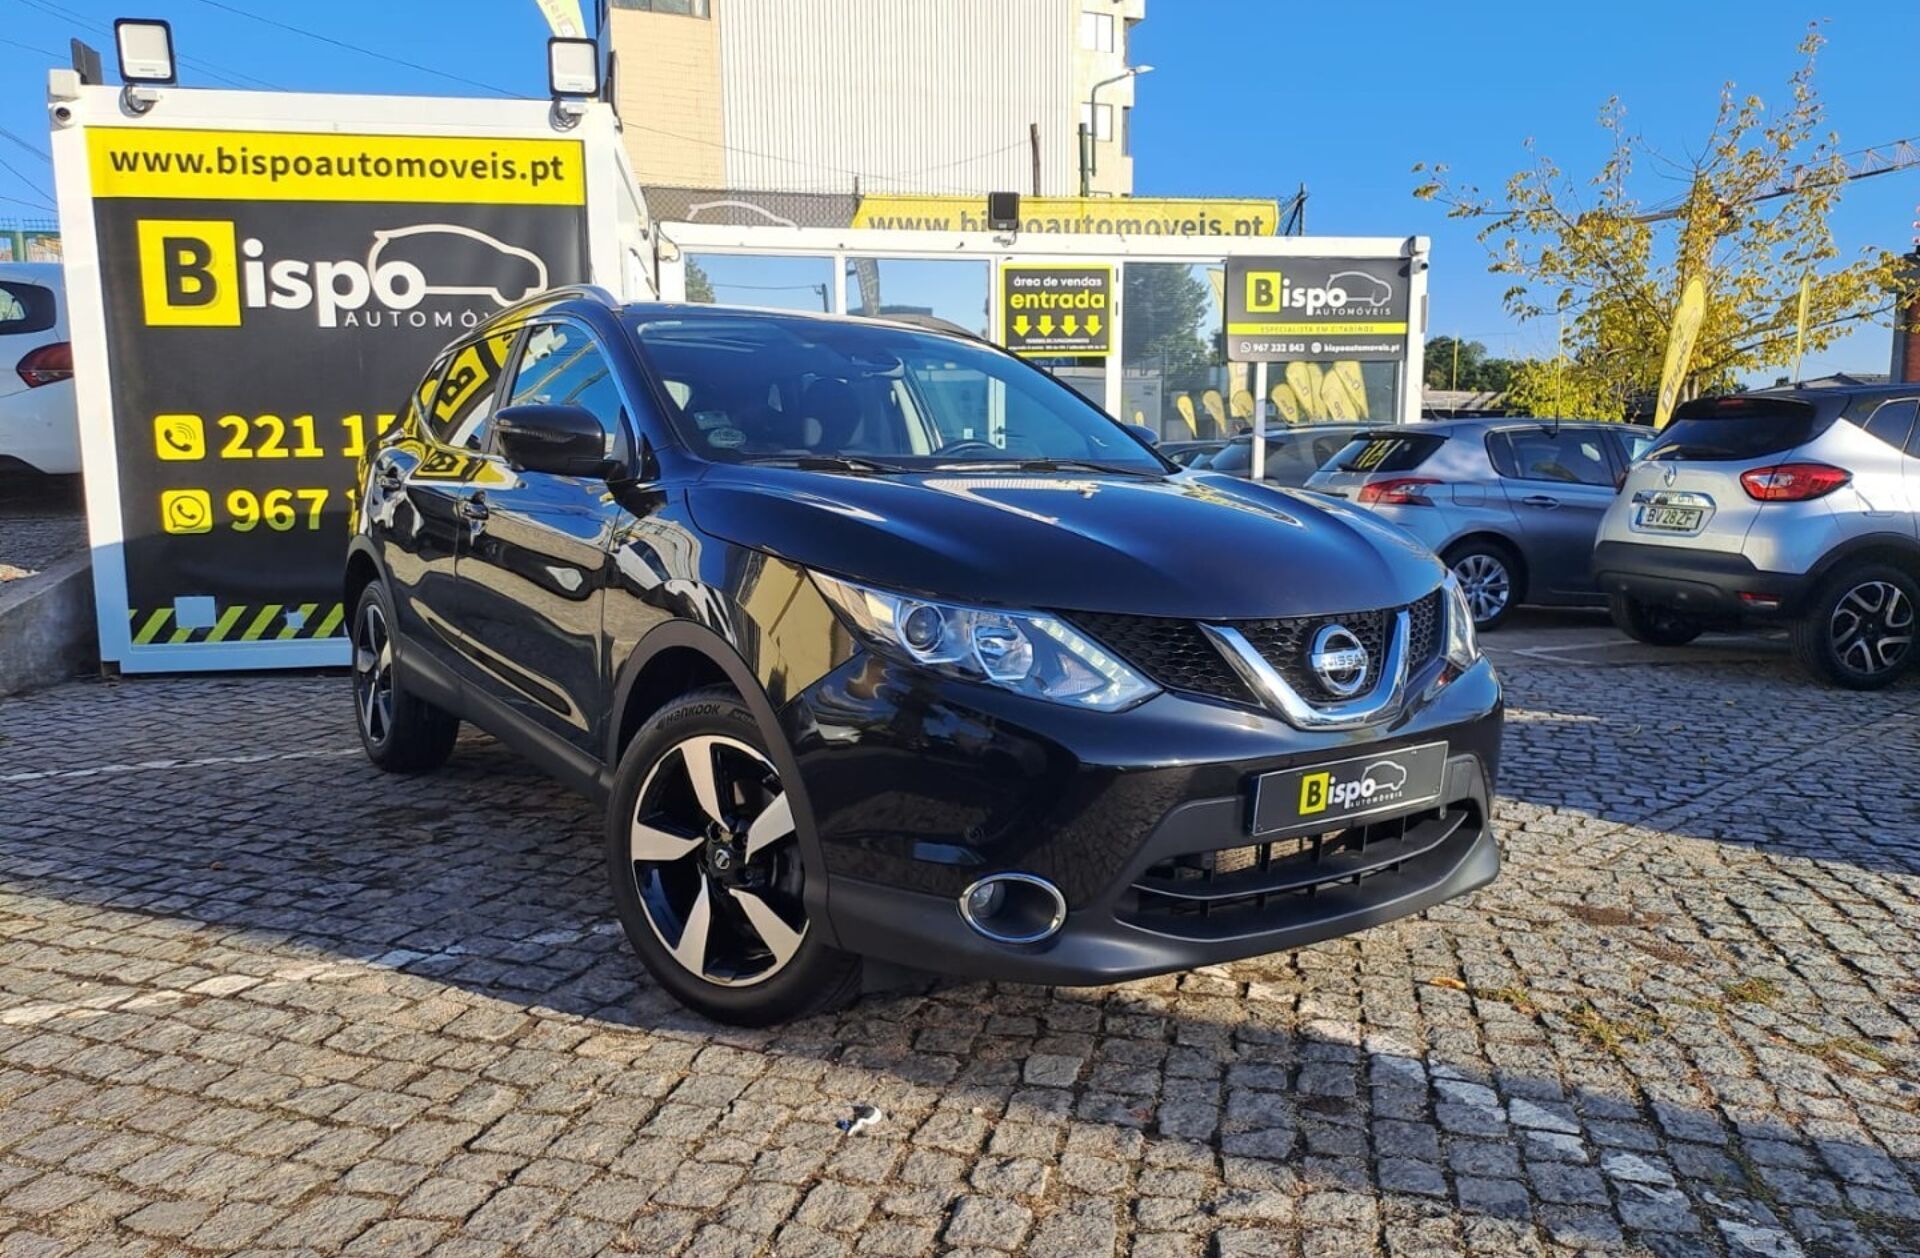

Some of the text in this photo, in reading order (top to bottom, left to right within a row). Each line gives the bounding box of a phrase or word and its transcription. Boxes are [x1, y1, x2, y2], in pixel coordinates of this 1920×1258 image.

[109, 146, 566, 187] www.bispoautomoveis.pt
[159, 235, 427, 328] Bispo
[1010, 288, 1105, 309] entrada
[1043, 276, 1058, 287] de
[1060, 276, 1102, 287] vendas
[1252, 277, 1348, 316] Bispo
[344, 308, 491, 328] AUTOMÓ
[1315, 306, 1391, 316] AUTOMÓVEIS
[217, 414, 325, 458] 221
[226, 488, 330, 533] 967
[1304, 774, 1377, 809] Bispo
